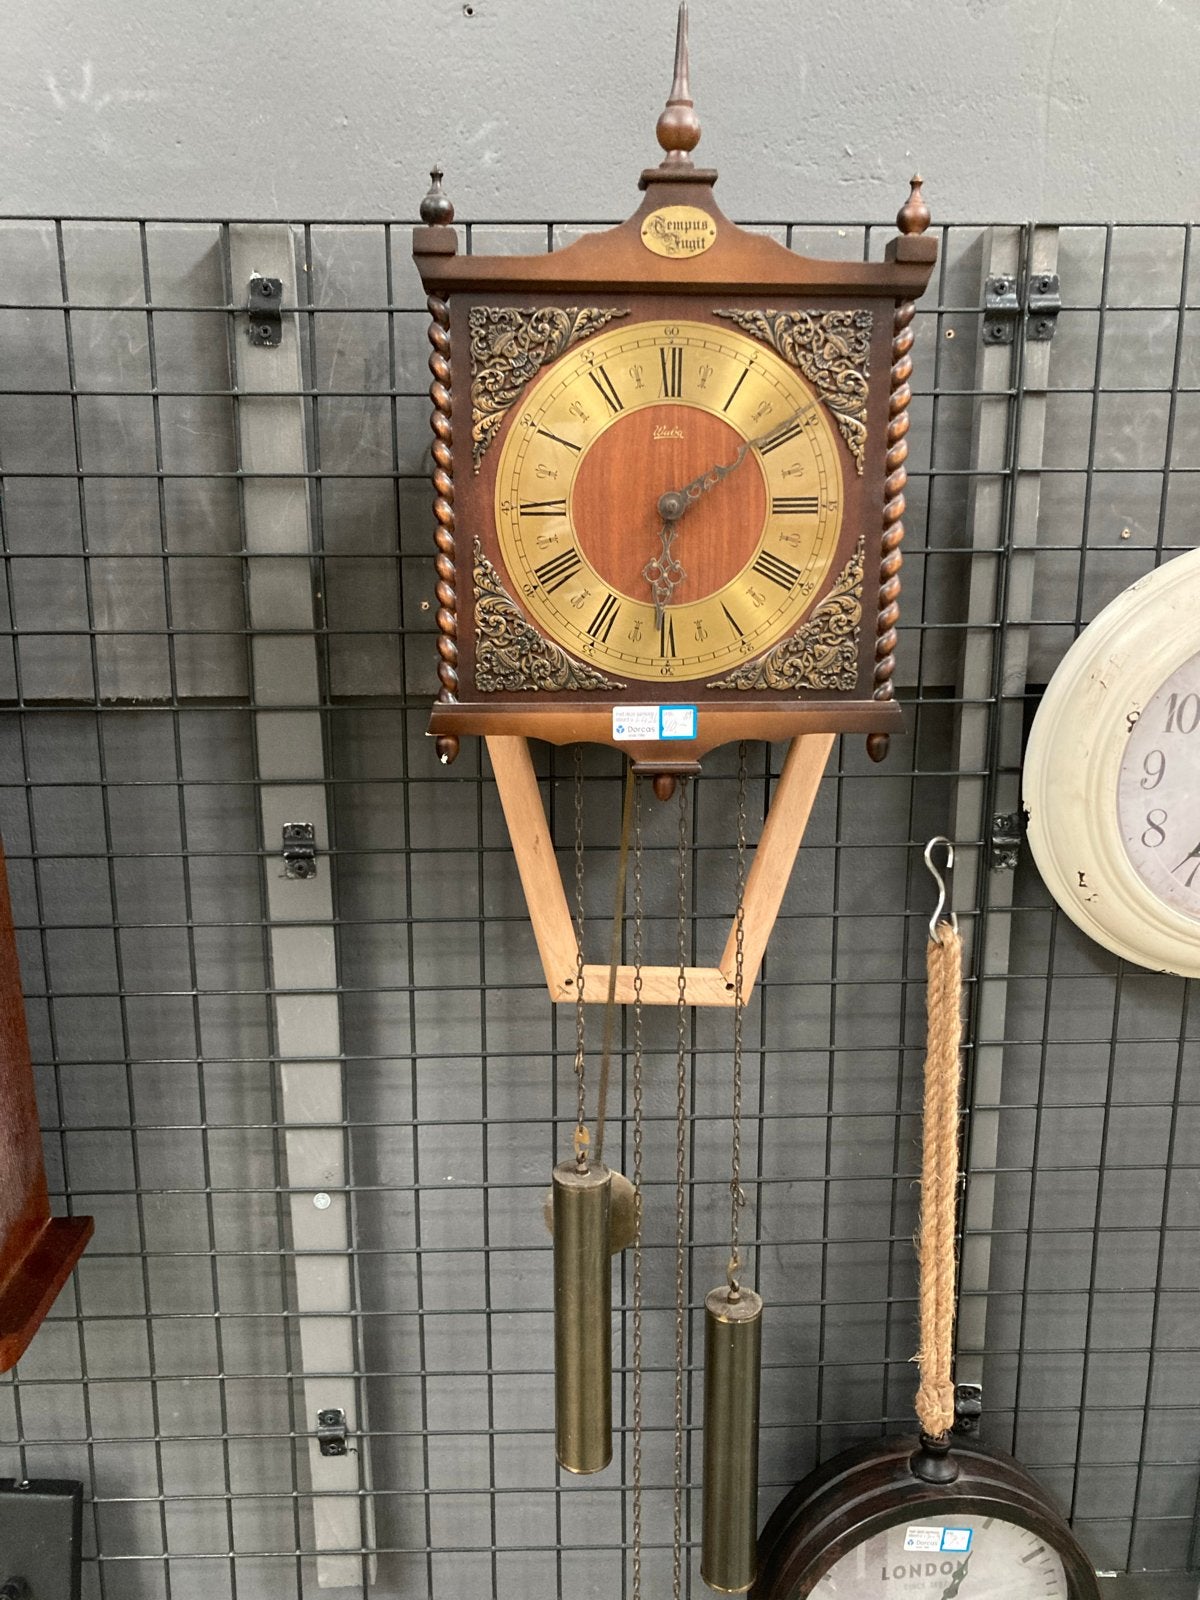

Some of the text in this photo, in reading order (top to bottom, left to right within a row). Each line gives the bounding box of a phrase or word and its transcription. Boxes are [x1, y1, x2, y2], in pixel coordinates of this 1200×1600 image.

[648, 215, 708, 235] Tempus
[664, 233, 705, 254] Fugit
[664, 327, 680, 336] 60
[580, 350, 595, 362] 55
[750, 351, 759, 361] 5
[658, 347, 684, 398] XII
[588, 364, 625, 418] XI
[723, 367, 750, 413] I
[519, 413, 533, 428] 50
[809, 414, 820, 427] 10
[536, 423, 583, 459] X
[501, 500, 511, 516] 45
[519, 498, 567, 517] IX
[772, 496, 819, 515] III
[827, 500, 838, 513] 15
[534, 547, 582, 595] VIII
[522, 583, 535, 600] 40
[801, 581, 815, 597] 20
[586, 593, 622, 644] VII
[719, 600, 744, 641] V
[582, 643, 597, 657] 35
[739, 643, 755, 656] 25
[659, 666, 676, 677] 30
[1163, 692, 1200, 735] 10
[627, 725, 656, 733] Dorcas
[1140, 749, 1167, 791] 9
[1141, 808, 1168, 848] 8
